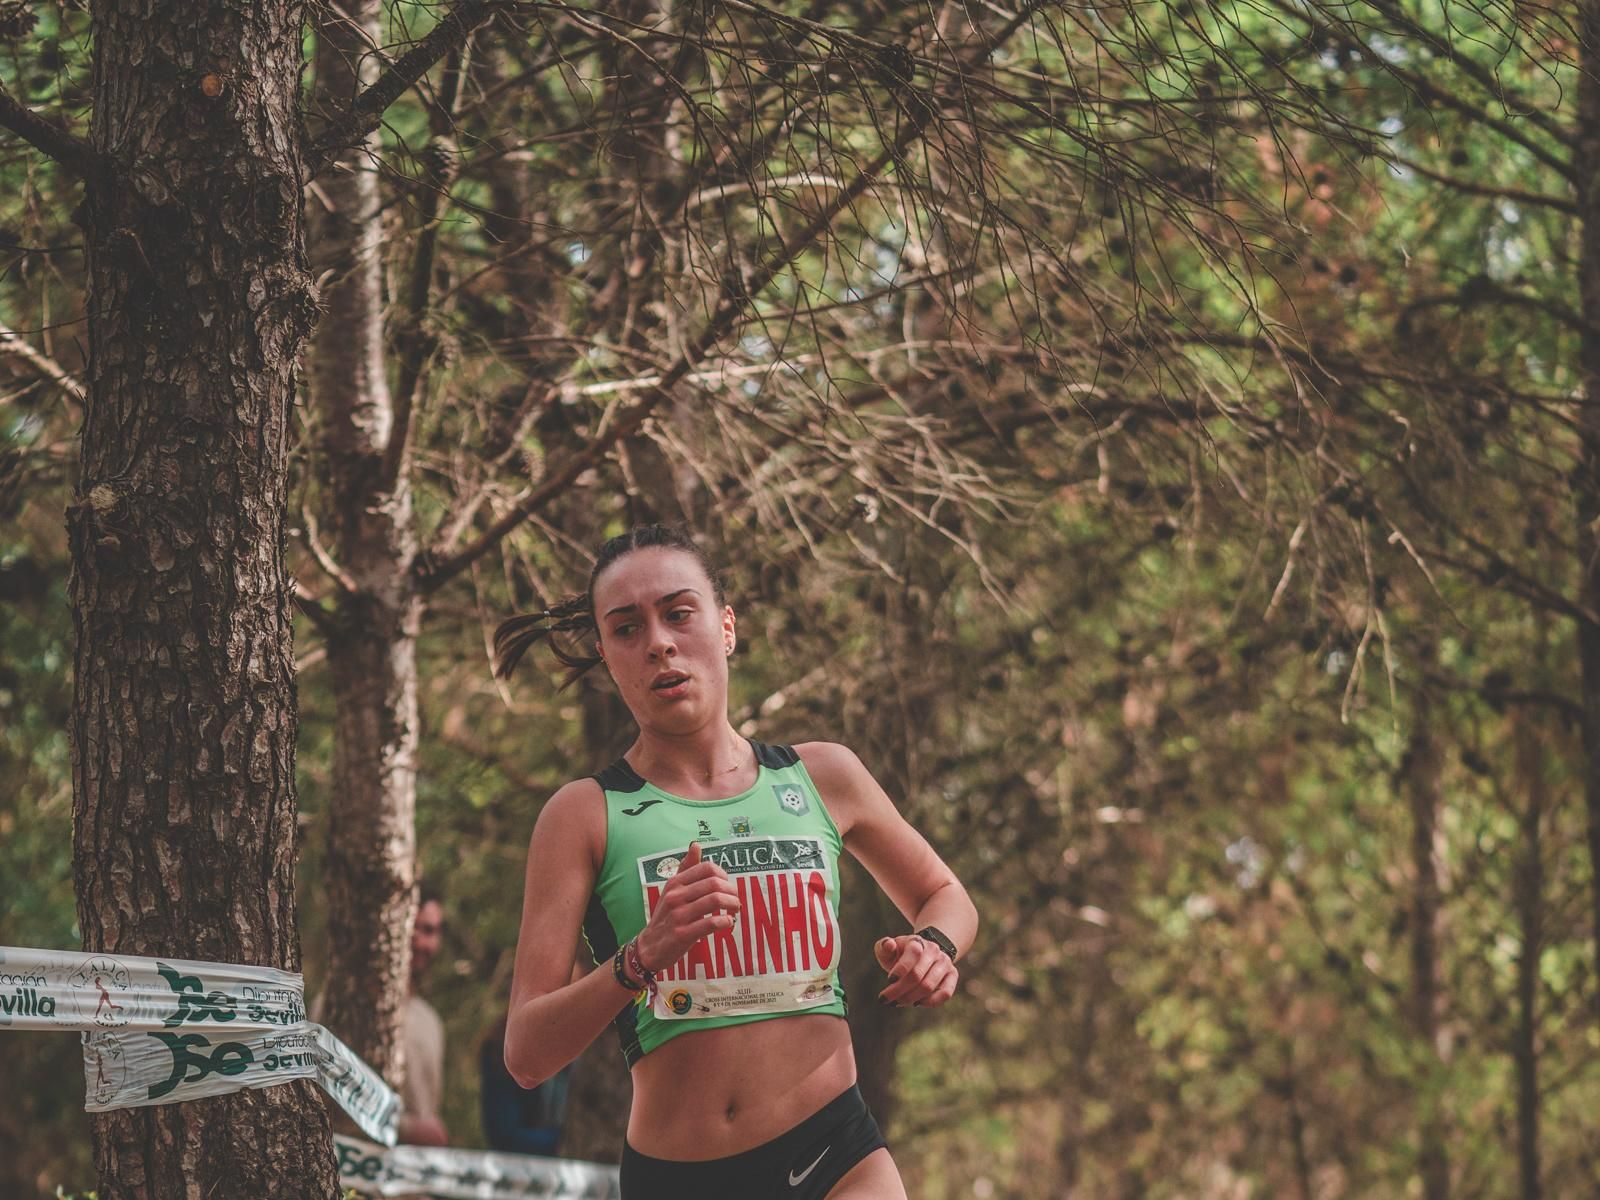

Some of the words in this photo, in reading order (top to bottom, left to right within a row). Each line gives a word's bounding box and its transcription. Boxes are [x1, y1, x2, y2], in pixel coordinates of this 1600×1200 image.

[703, 847, 784, 868] TÁLICA
[647, 871, 834, 982] ARINHO
[0, 988, 56, 1017] villa
